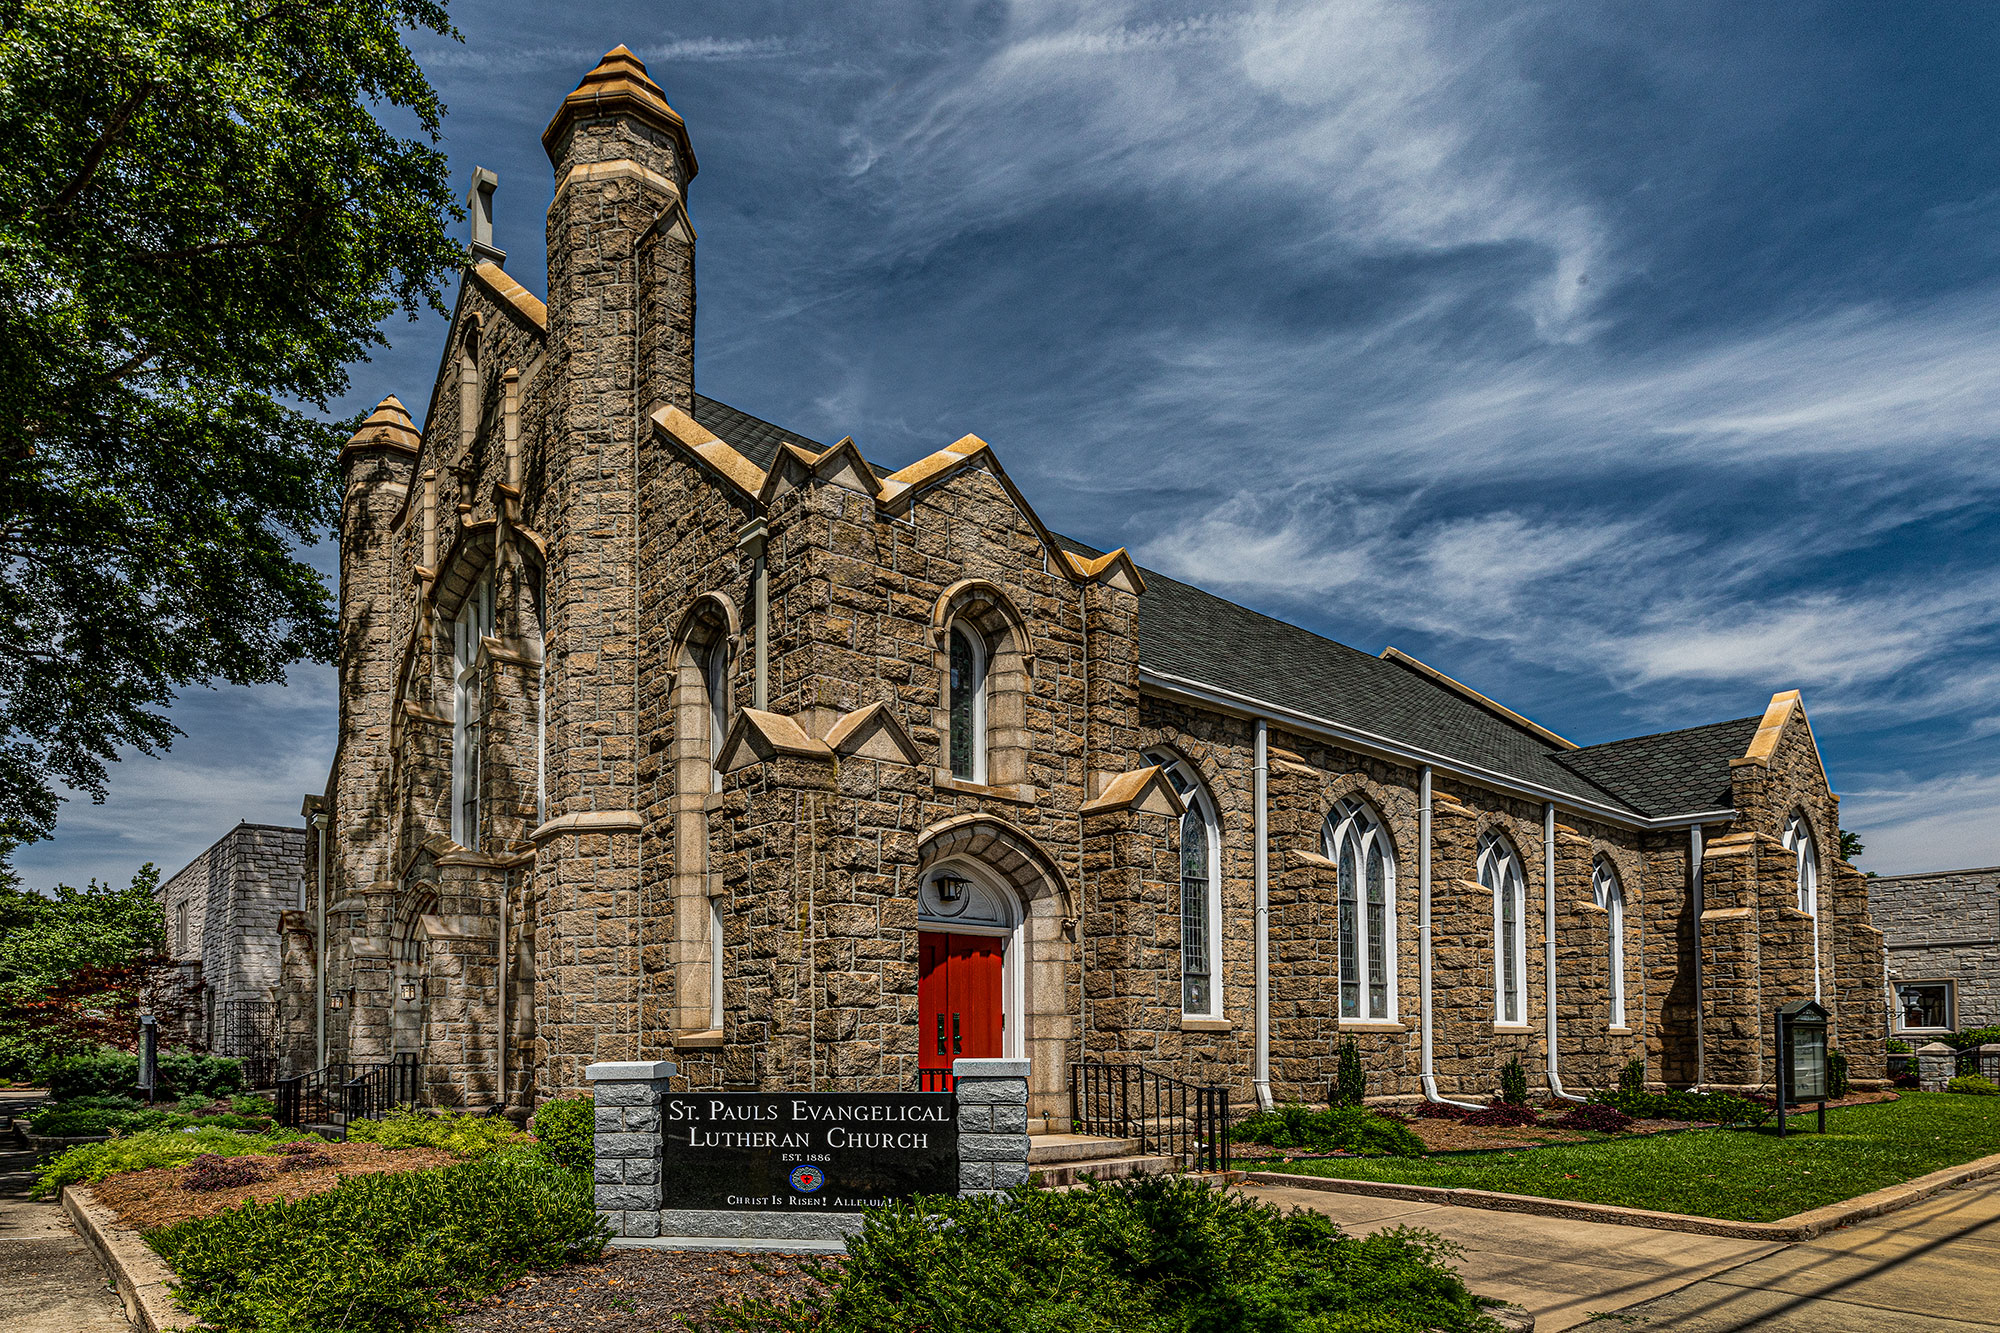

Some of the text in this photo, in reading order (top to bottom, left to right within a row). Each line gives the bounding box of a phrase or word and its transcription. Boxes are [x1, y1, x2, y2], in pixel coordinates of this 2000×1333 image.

[669, 1100, 950, 1122] ST. PAULS EVANGELICAL
[688, 1126, 928, 1149] LUTHERAN CHURCH
[782, 1153, 831, 1162] EST. 1886
[727, 1195, 769, 1205] CHRIST
[772, 1195, 782, 1205] IS
[789, 1195, 827, 1206] RISEN!
